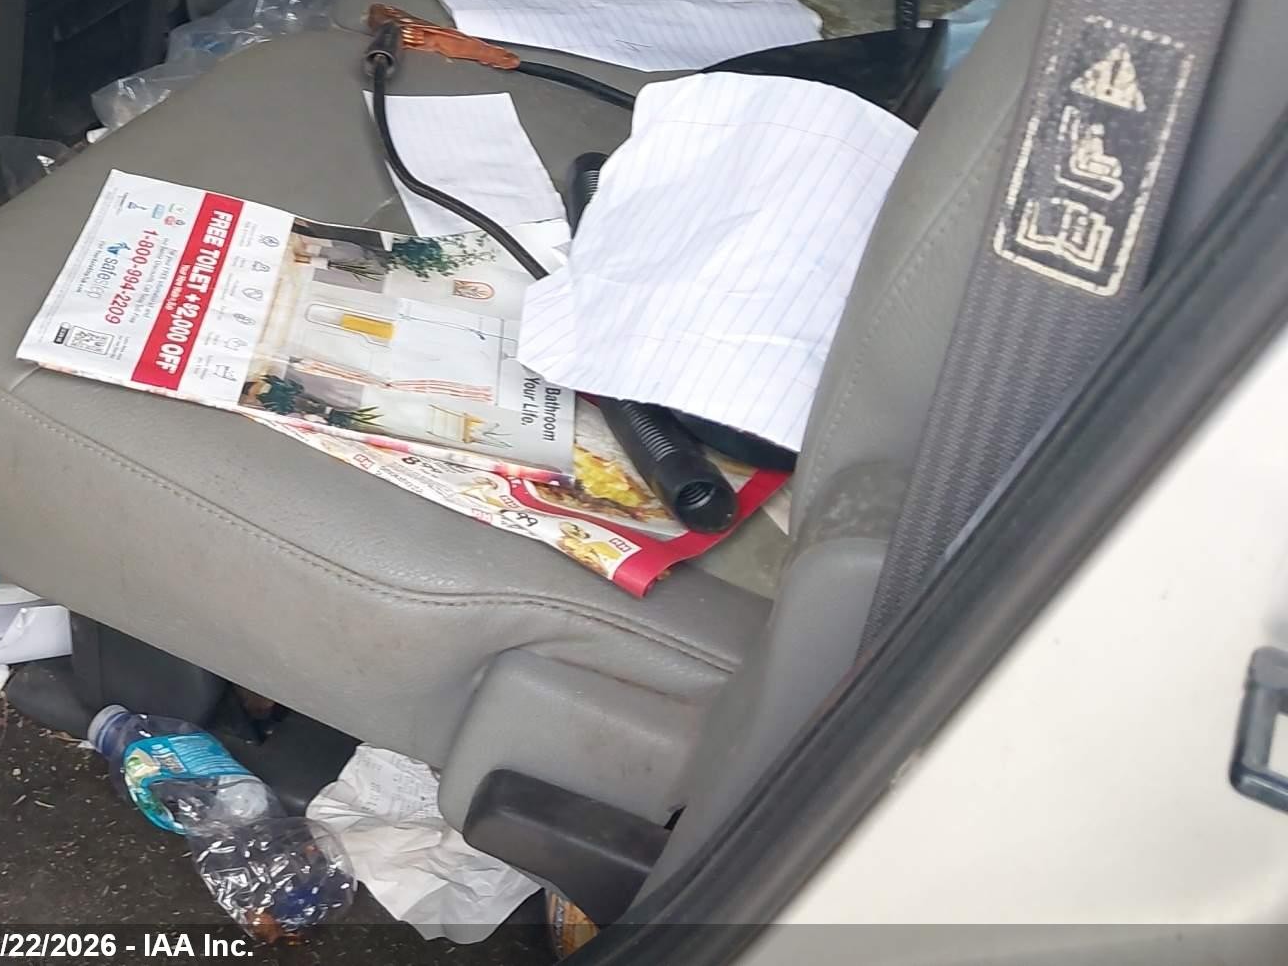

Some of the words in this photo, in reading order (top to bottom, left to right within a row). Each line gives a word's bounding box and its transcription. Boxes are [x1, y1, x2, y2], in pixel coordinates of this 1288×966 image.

[203, 210, 235, 248] FREE
[105, 230, 159, 325] 1-800-994-2209
[186, 248, 221, 293] TOILET
[154, 343, 184, 374] OFF
[523, 377, 541, 401] Your
[521, 403, 539, 426] Life.
[543, 387, 561, 441] Bathroom
